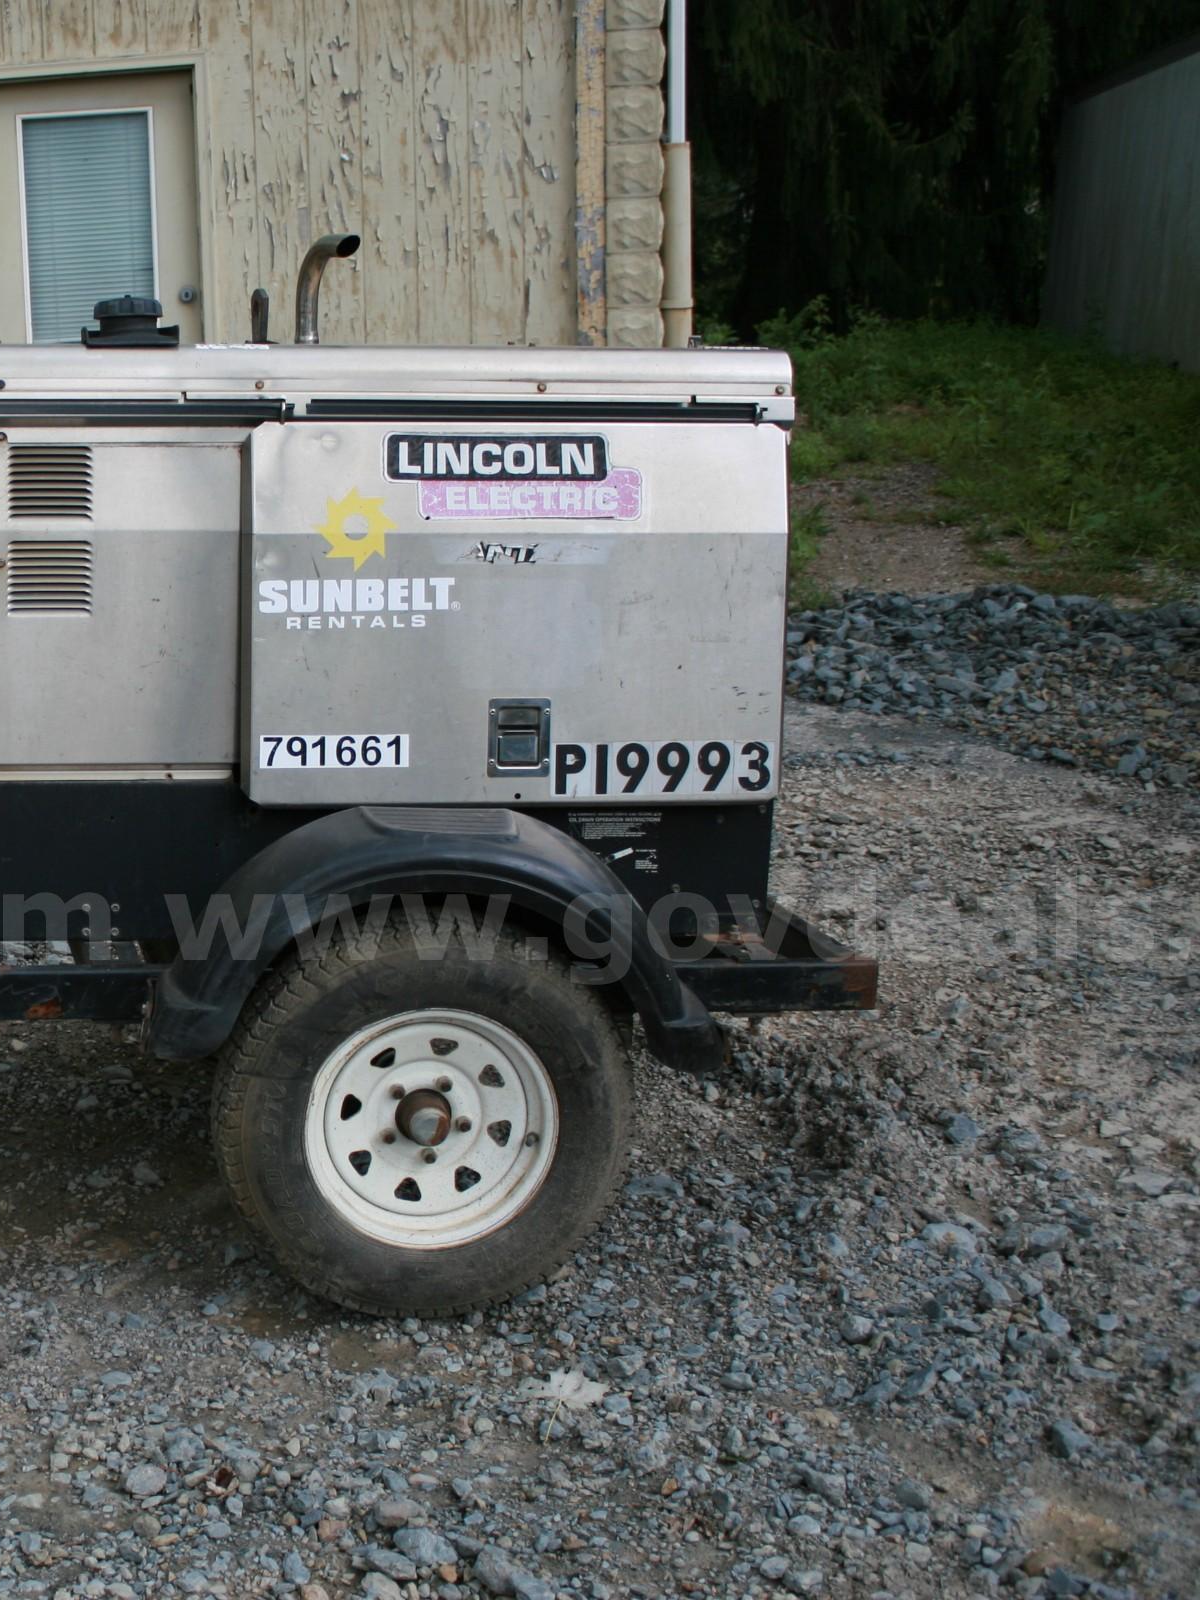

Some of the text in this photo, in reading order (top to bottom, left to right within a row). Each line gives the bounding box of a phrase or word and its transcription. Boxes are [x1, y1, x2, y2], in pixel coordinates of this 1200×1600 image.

[398, 441, 595, 476] LINCOLN
[445, 486, 619, 511] ELECTRIC
[286, 614, 427, 630] RENTALS
[262, 735, 402, 767] 791661
